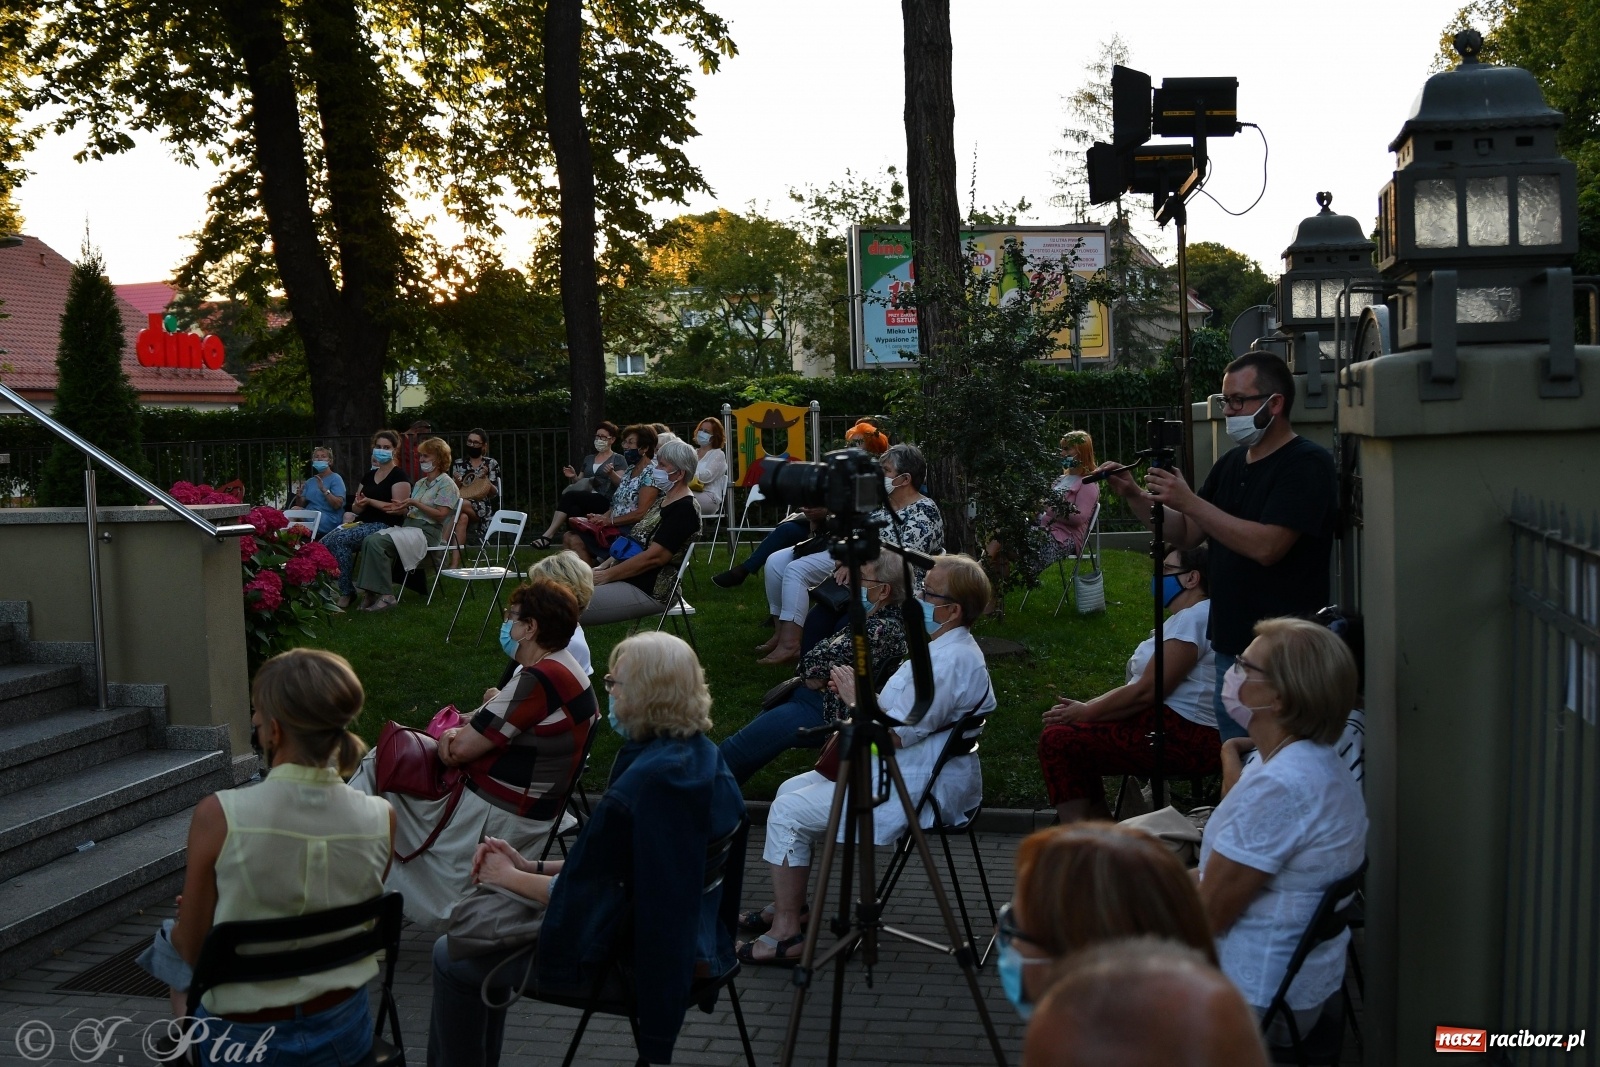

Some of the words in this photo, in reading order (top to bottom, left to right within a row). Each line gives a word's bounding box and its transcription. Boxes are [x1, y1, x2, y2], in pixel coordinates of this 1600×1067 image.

[868, 240, 904, 255] dino
[136, 313, 225, 370] dino
[855, 635, 867, 676] Nikon
